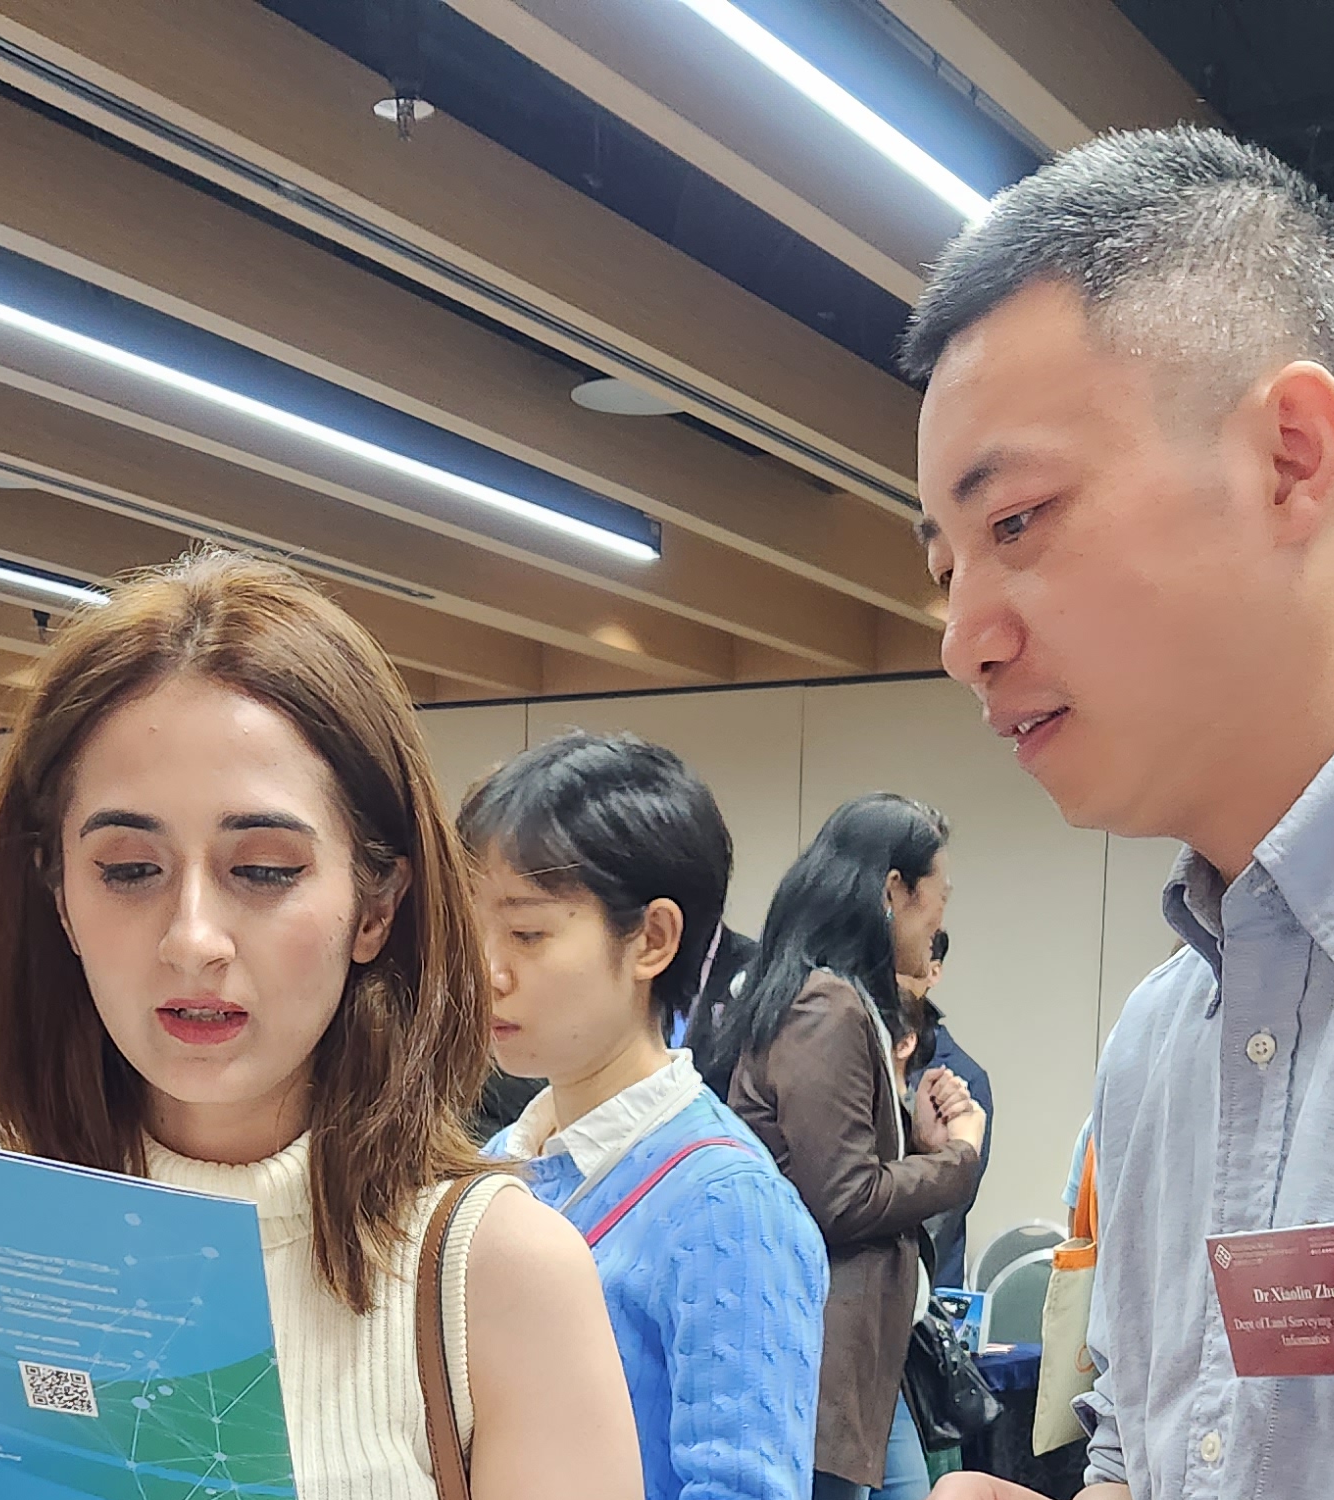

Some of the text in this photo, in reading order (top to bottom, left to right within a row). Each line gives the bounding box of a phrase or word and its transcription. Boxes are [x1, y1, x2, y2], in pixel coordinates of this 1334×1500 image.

[1254, 1288, 1270, 1303] Dr
[1271, 1285, 1312, 1303] Xiaolin
[1265, 1316, 1287, 1329] Land
[1288, 1315, 1332, 1333] Surveying
